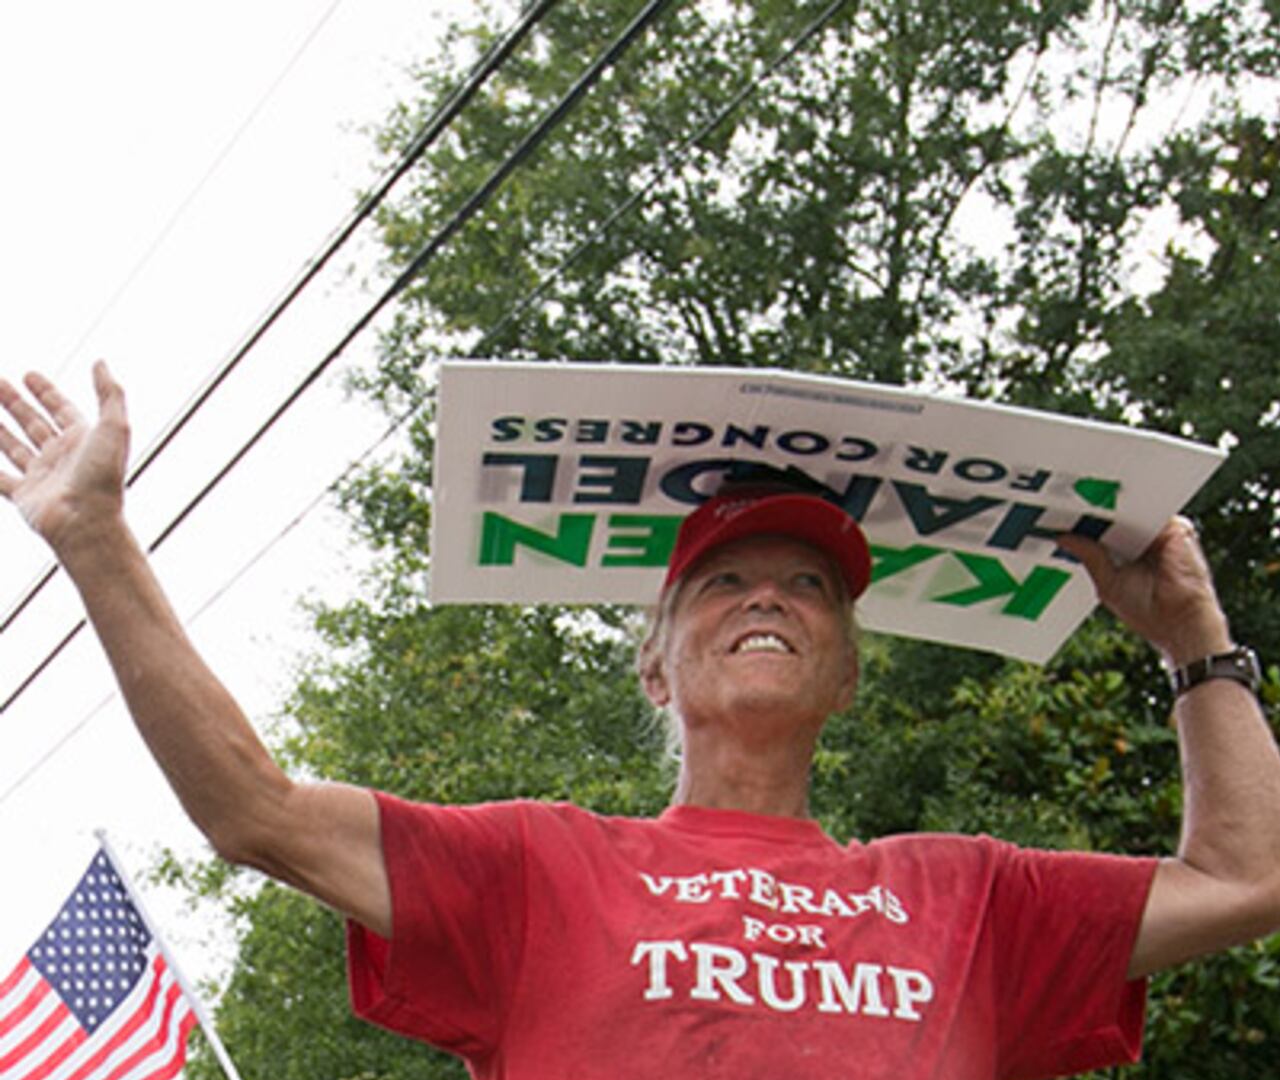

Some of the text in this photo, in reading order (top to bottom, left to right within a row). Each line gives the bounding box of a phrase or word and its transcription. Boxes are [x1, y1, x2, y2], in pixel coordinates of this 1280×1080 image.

[491, 416, 1051, 493] FOR CONGRESS
[639, 868, 910, 924] VETERANS
[742, 916, 827, 948] FOR
[629, 940, 935, 1022] TRUMP
